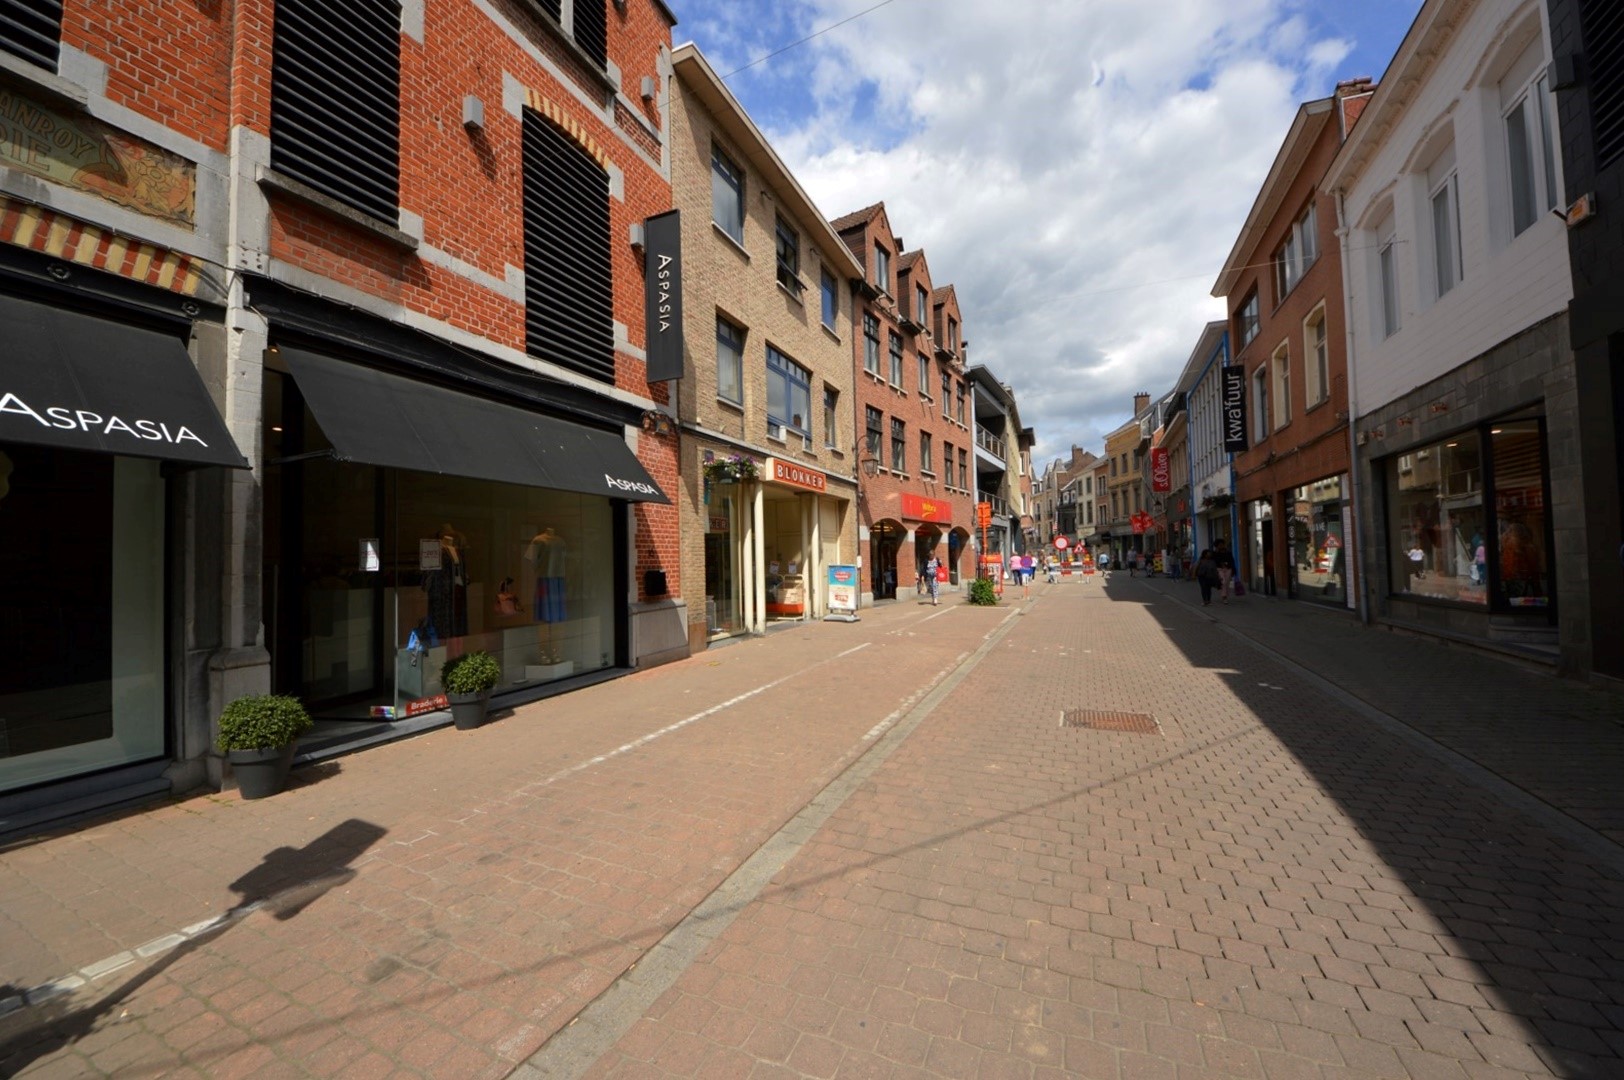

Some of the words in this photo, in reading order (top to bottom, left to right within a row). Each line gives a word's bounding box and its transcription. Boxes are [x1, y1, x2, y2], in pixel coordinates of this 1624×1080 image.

[657, 254, 673, 333] ASPASIA
[0, 392, 209, 448] ASPASIA
[1224, 373, 1243, 442] kwa'fuur
[605, 474, 659, 495] ASPASIA
[777, 464, 823, 489] BLOKKER
